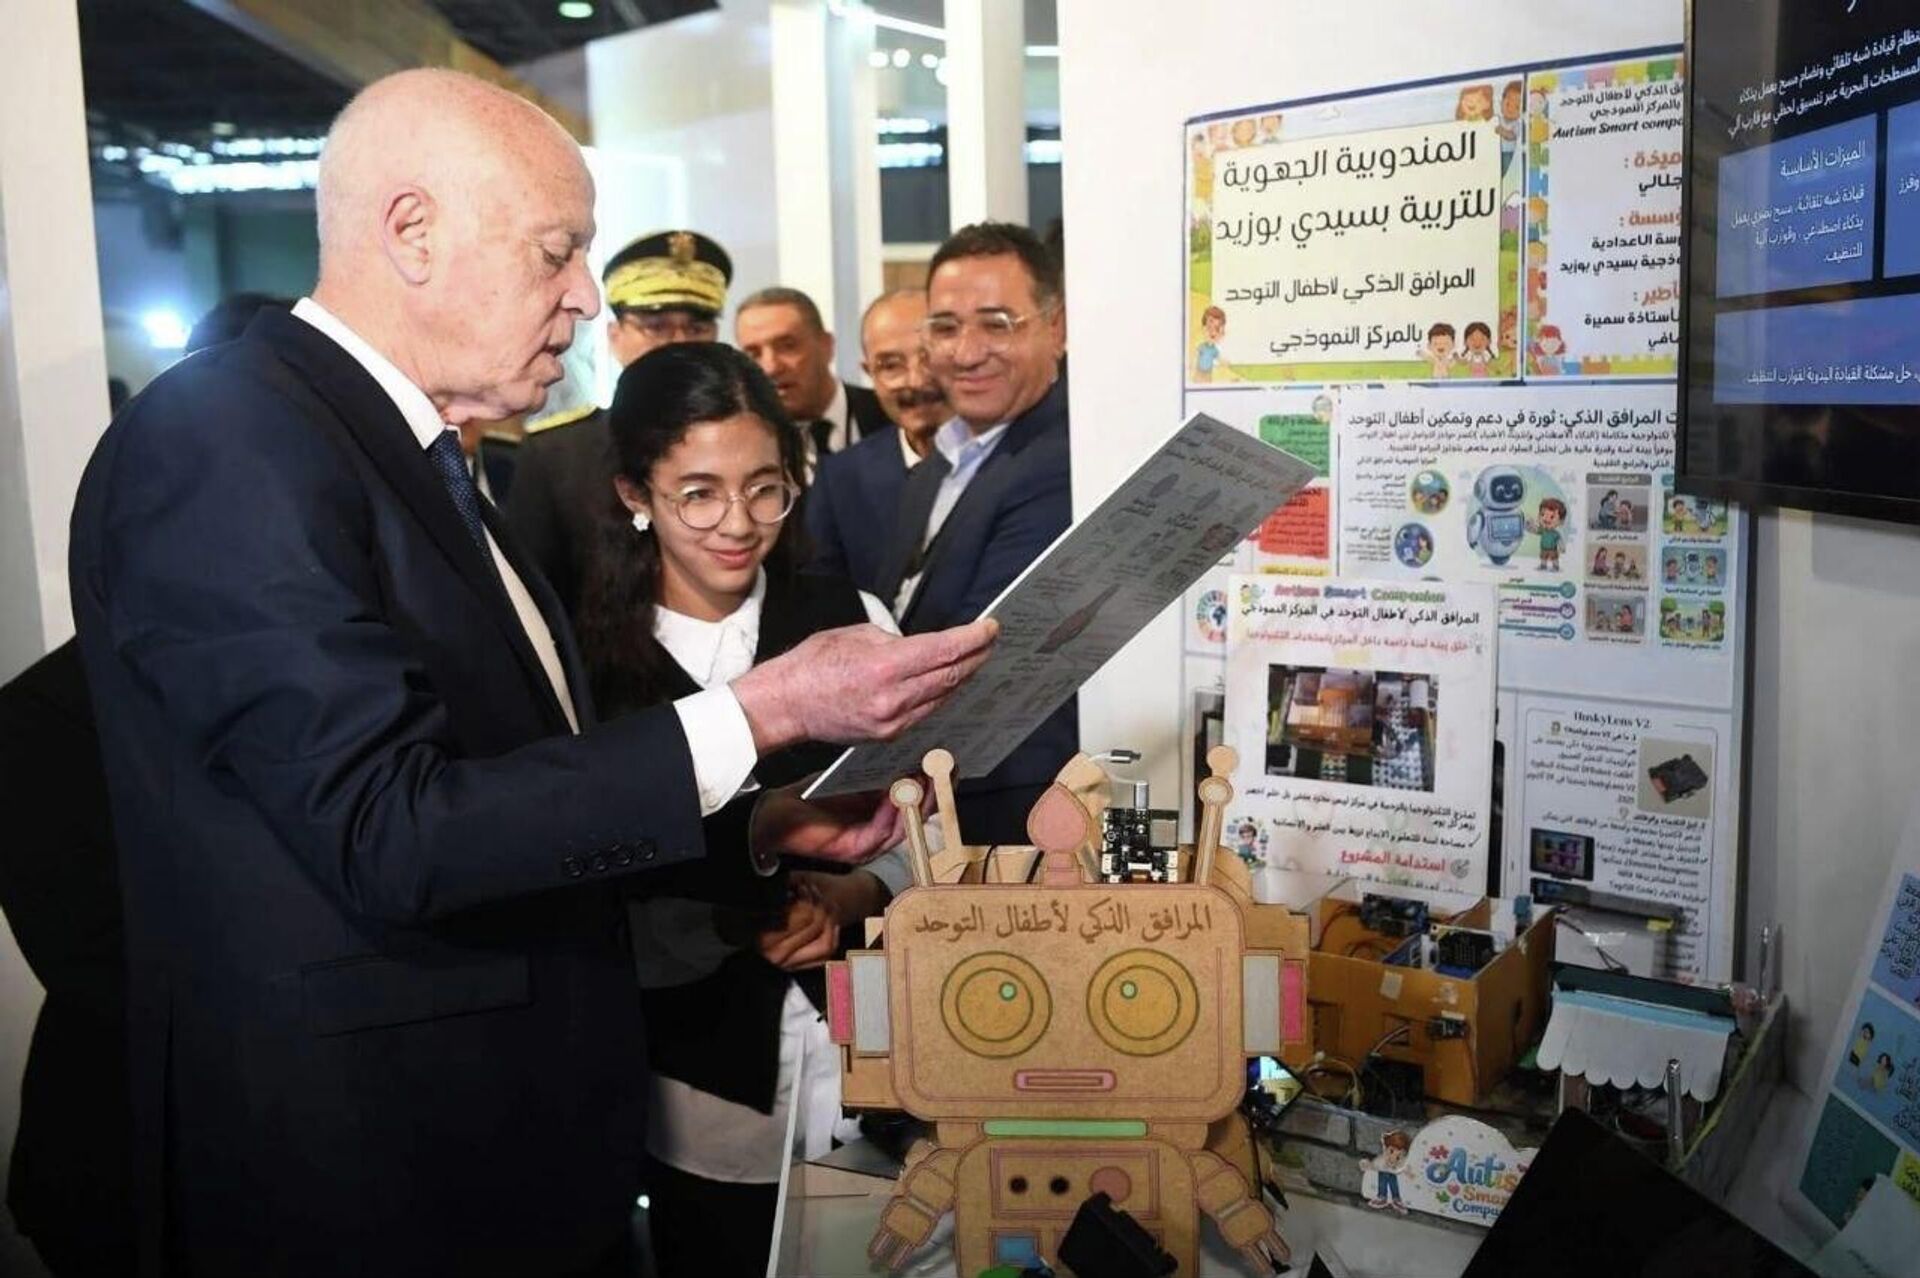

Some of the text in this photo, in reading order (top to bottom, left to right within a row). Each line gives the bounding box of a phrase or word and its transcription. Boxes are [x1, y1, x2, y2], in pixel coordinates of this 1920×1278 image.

[1853, 44, 1871, 63] شبه
[1872, 34, 1896, 57] قيادة
[1634, 84, 1667, 100] الذكي
[1824, 88, 1838, 106] عبر
[1839, 74, 1868, 99] البحرية
[1559, 93, 1594, 107] التوحد
[1590, 103, 1644, 121] النموذجي
[1553, 125, 1597, 139] Autism
[1598, 121, 1640, 135] Smart
[1222, 130, 1476, 192] المندوبية الجهوية
[1779, 139, 1866, 178] الميزات الأساسية
[1215, 187, 1496, 249] للتربية بسيدي بوزيد
[1560, 258, 1591, 275] بوزيد
[1592, 258, 1639, 277] بسيدي
[1225, 279, 1281, 306] التوحد
[1342, 272, 1405, 305] الذكي
[1408, 267, 1475, 297] المرافق
[1584, 312, 1626, 329] سميرة
[1269, 321, 1423, 358] بالمركز النموذجي
[1806, 364, 1833, 387] اليدوية
[1834, 363, 1863, 385] القيادة
[1864, 361, 1894, 383] مشكلة
[1894, 362, 1912, 385] حل
[1348, 411, 1387, 429] التوحد
[1388, 406, 1426, 428] أطفال
[1427, 410, 1474, 430] وتمكين
[1476, 412, 1503, 432] دعم
[1505, 409, 1526, 434] في
[1528, 408, 1557, 429] ثورة
[1559, 408, 1604, 434] الذكي:
[1607, 408, 1662, 429] المرافق
[1241, 601, 1288, 617] النموذجي
[1289, 602, 1319, 618] المركز
[1320, 605, 1335, 621] في
[1338, 605, 1370, 623] التوحد
[1409, 608, 1438, 627] الذكي
[1440, 608, 1480, 628] المرافق
[1340, 849, 1446, 873] استدامة المشروع
[914, 896, 1212, 944] المرافق الذكي لأطفال التوحد
